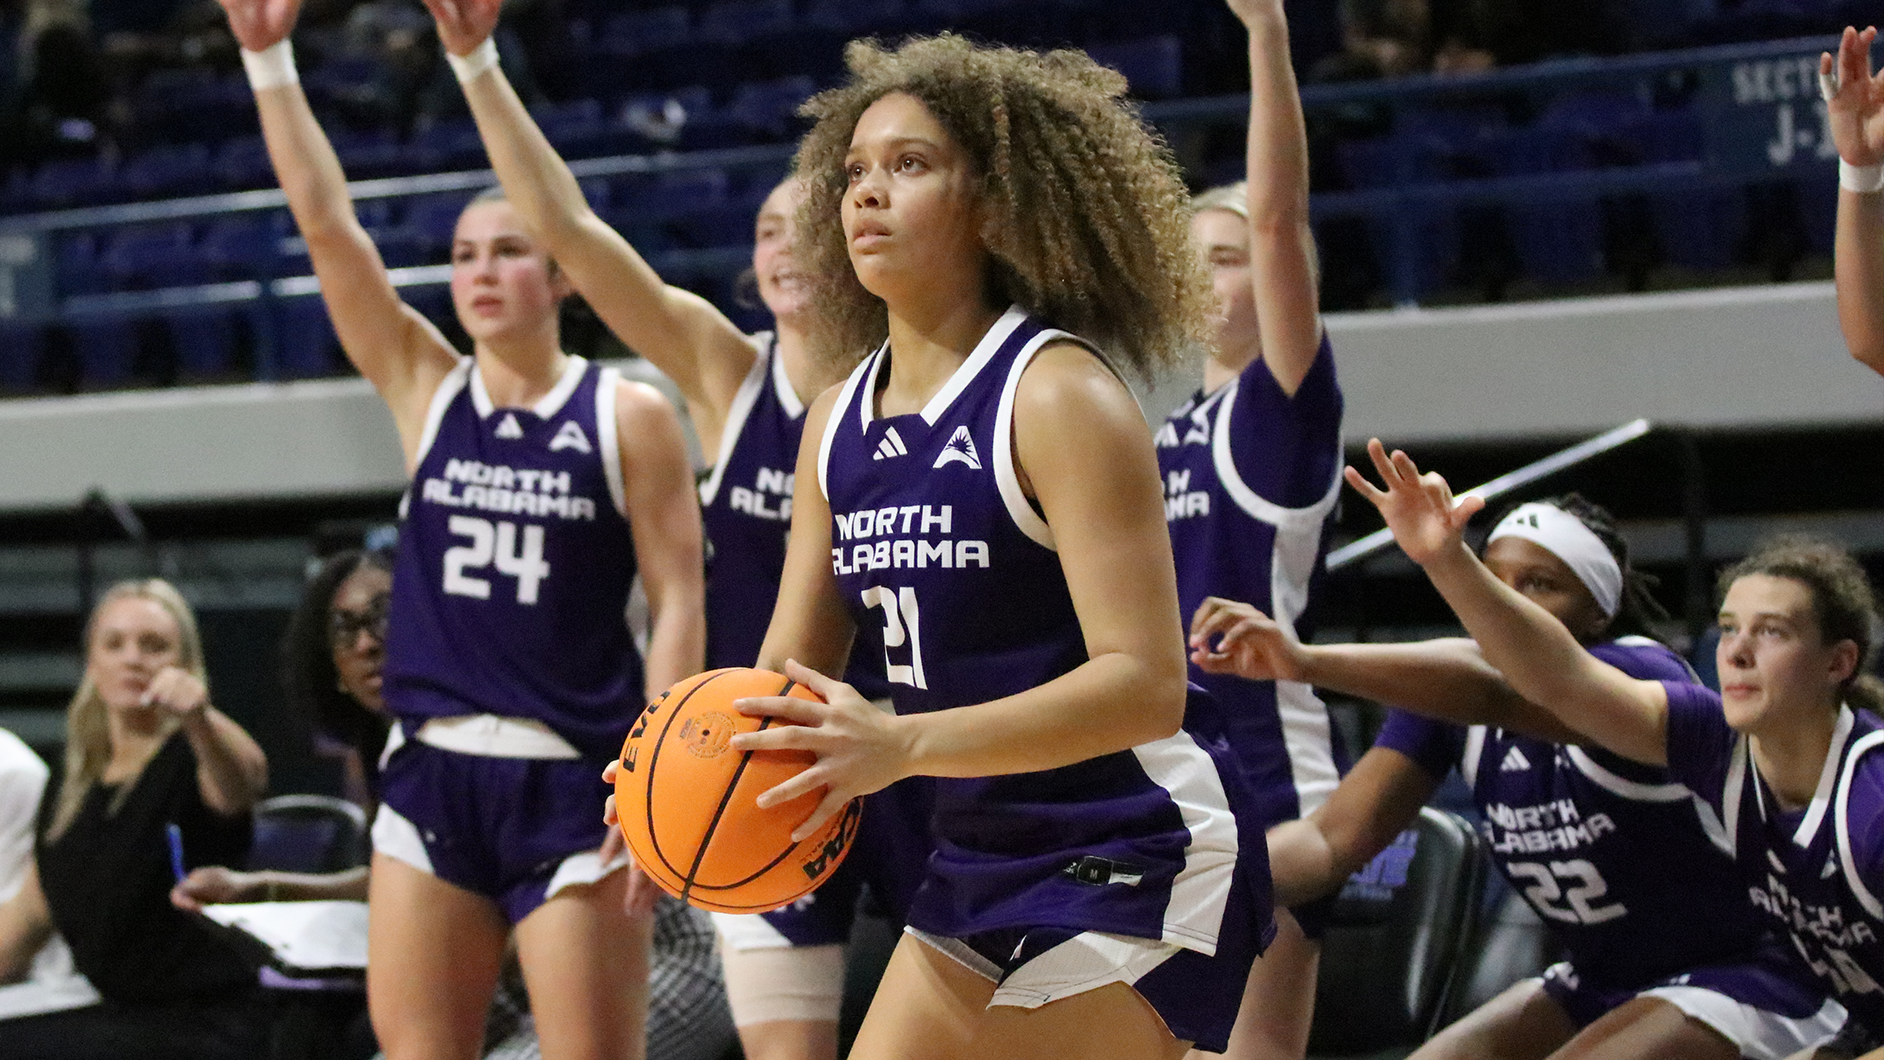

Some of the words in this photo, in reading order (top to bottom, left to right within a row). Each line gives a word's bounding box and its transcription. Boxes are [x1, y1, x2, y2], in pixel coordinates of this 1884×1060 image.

[1732, 58, 1824, 104] SECT
[443, 457, 571, 493] NORTH
[422, 477, 596, 521] ALABAMA
[834, 504, 953, 541] NORTH
[442, 514, 550, 606] 24
[831, 539, 990, 576] ALABAMA
[860, 584, 928, 691] 21
[1486, 798, 1581, 830] NORTH
[802, 796, 862, 881] CAA
[1506, 859, 1628, 924] 22
